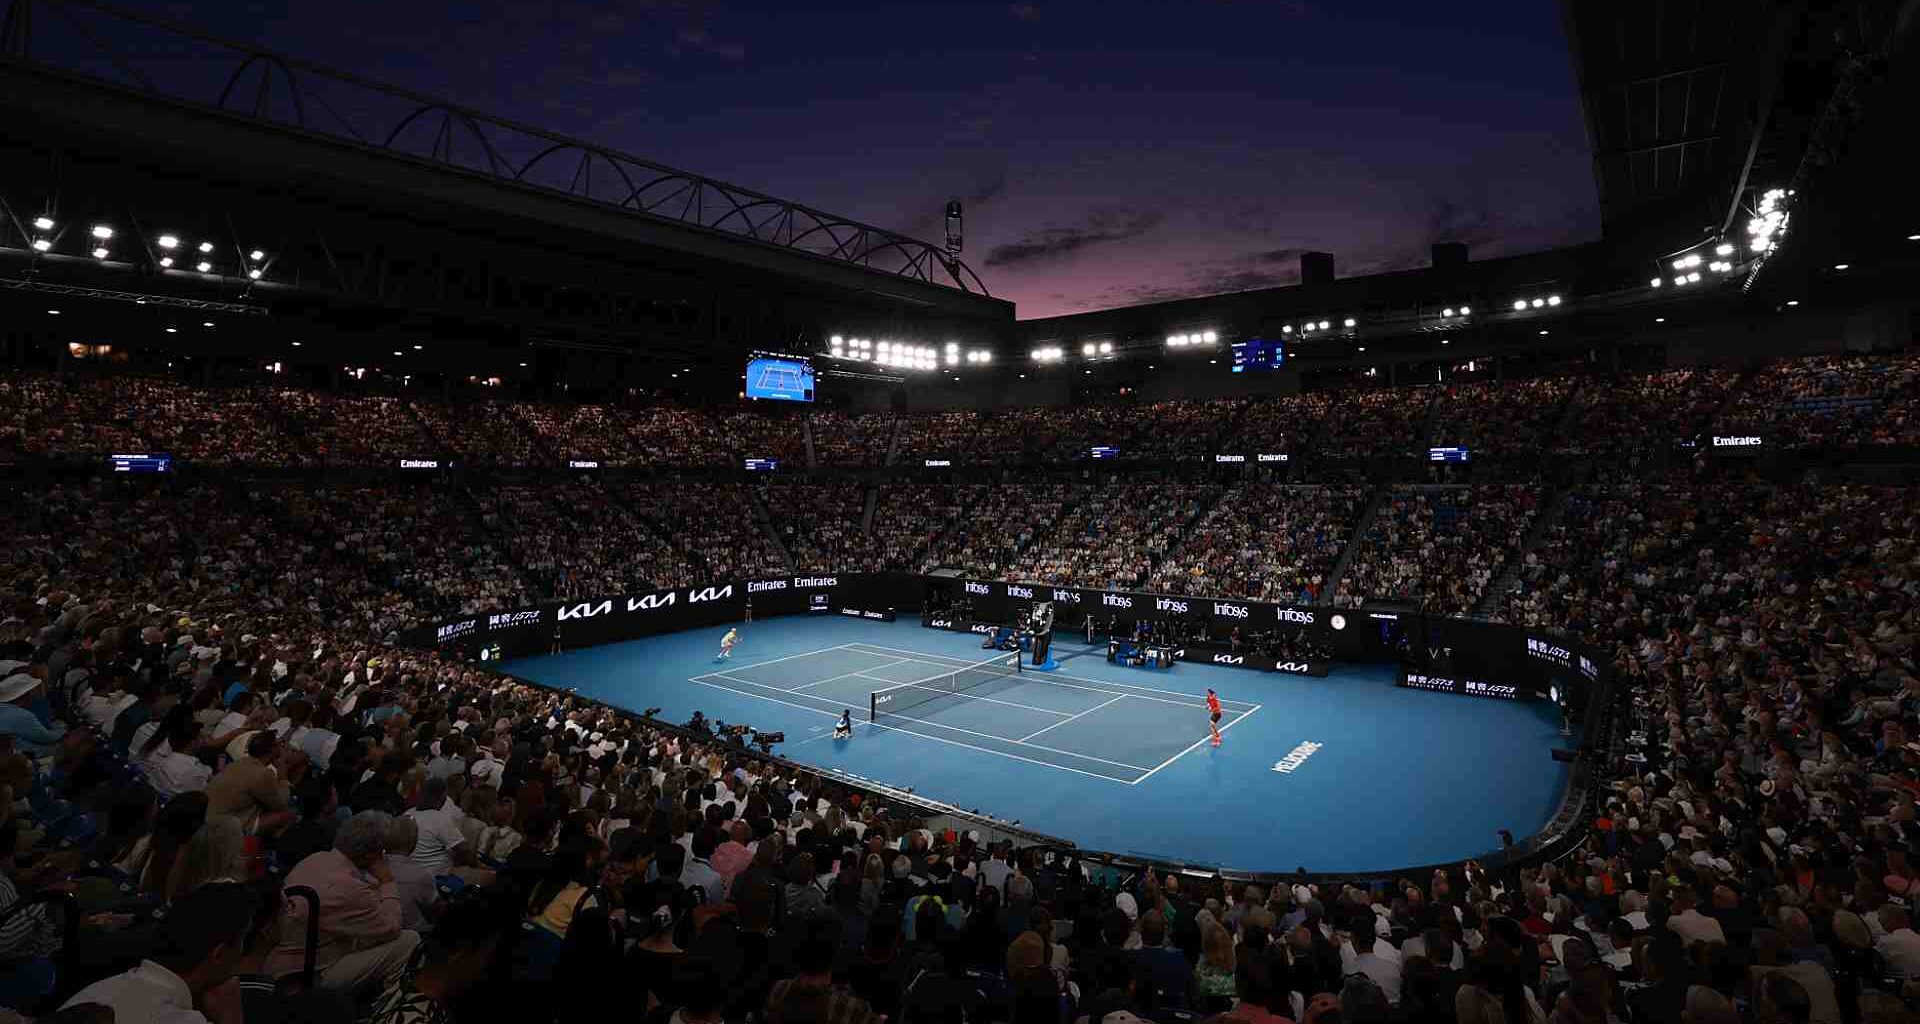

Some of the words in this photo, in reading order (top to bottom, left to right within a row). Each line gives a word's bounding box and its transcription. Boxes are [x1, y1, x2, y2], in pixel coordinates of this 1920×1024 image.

[1713, 436, 1762, 446] Emirates
[400, 459, 438, 468] Emirates
[747, 580, 787, 592] Emirates
[794, 576, 838, 588] Emirates
[689, 585, 732, 603] KIA
[1007, 584, 1033, 599] Infosys
[627, 592, 676, 611] KIA
[1103, 593, 1133, 608] Infosys
[1156, 597, 1188, 613] Infosys
[557, 600, 612, 621] KIA
[1214, 602, 1249, 619] Infosys
[1277, 607, 1314, 624] Infosys
[1213, 653, 1244, 664] KIA
[1276, 661, 1308, 673] KIA
